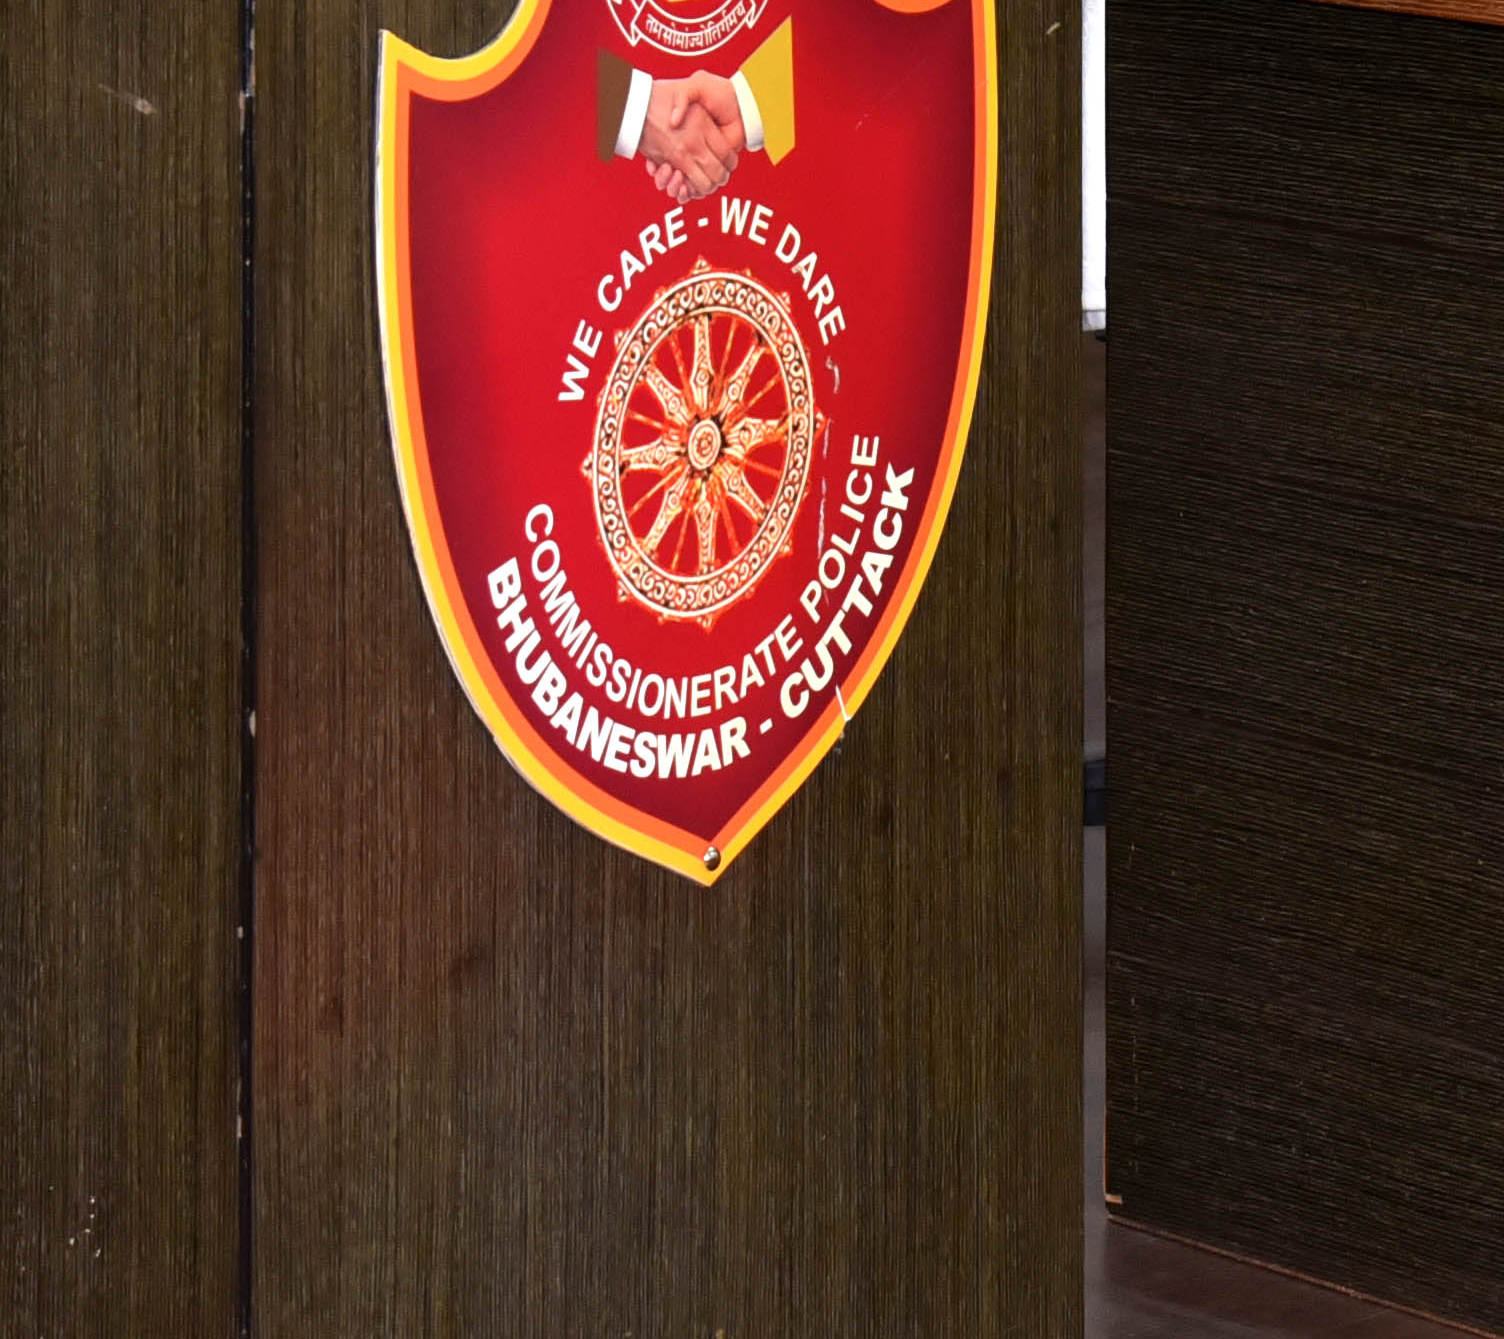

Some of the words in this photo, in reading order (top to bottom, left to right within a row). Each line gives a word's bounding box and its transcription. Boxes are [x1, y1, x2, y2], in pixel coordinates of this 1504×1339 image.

[557, 319, 603, 403] WE
[597, 206, 688, 313] CARE
[720, 196, 774, 245] WE
[774, 223, 846, 345] DARE
[486, 556, 750, 779] BHUBANESWAR
[778, 462, 916, 719] CUTTACK
[524, 503, 804, 719] COMMISSIONERATE
[799, 433, 880, 622] POLICE
